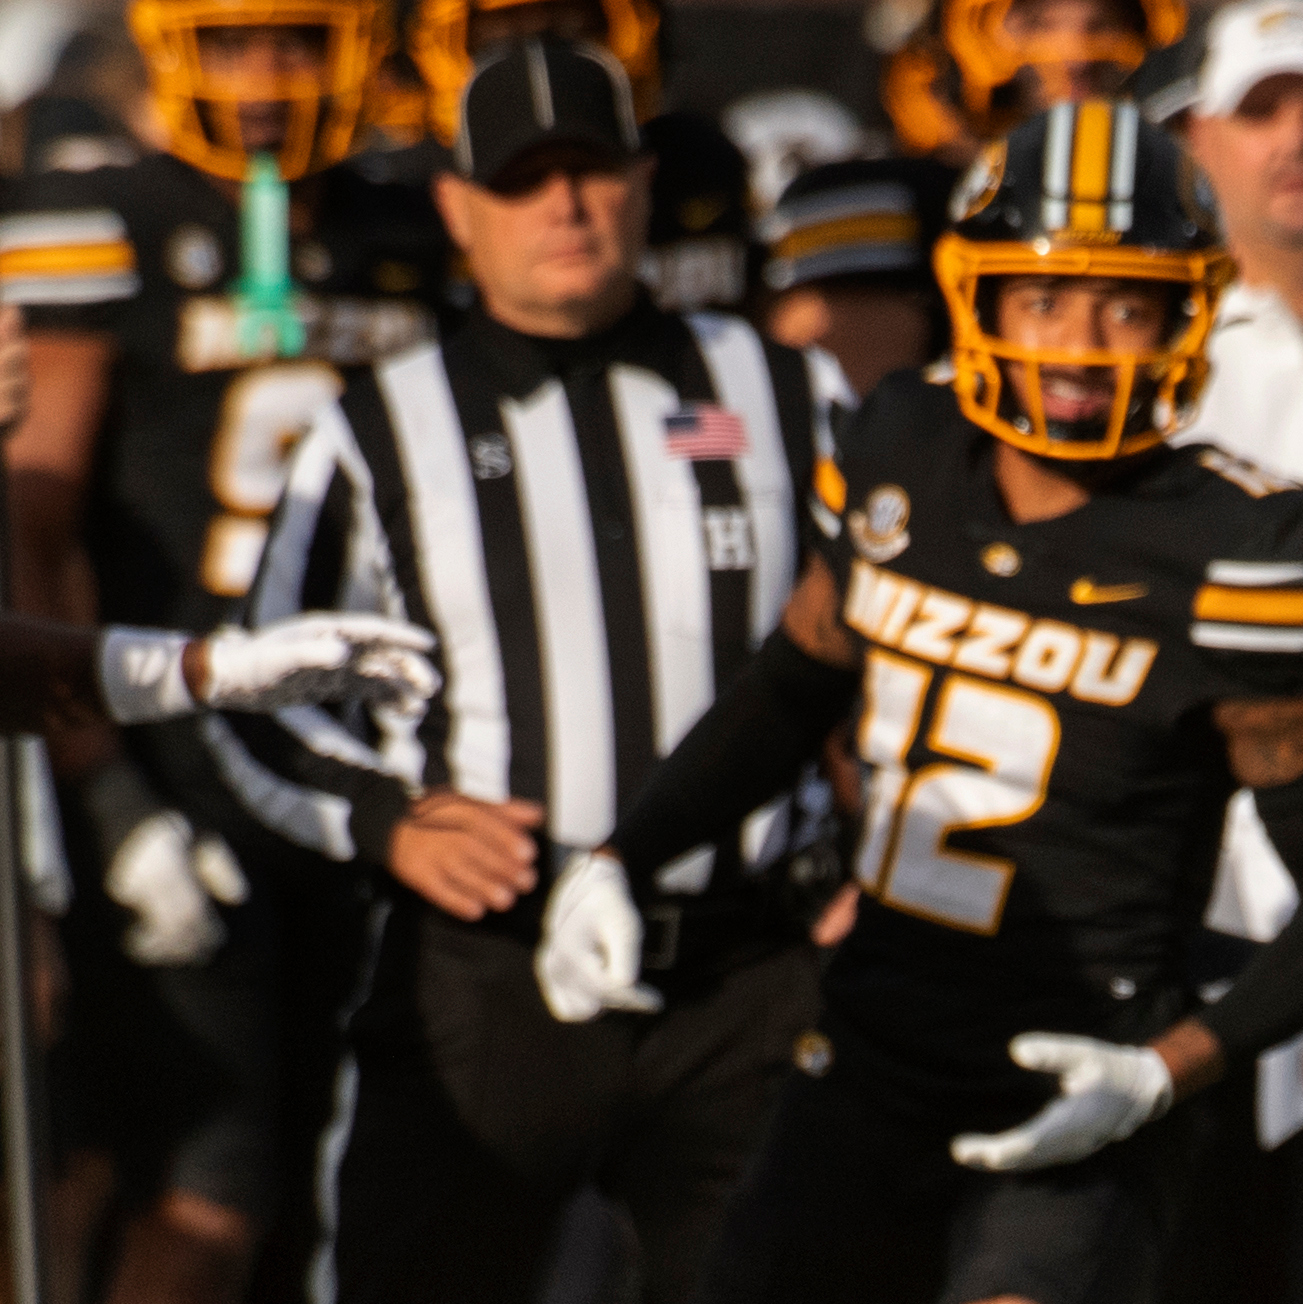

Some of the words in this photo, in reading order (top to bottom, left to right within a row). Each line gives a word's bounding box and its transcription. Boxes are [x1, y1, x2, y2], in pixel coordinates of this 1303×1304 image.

[704, 507, 758, 571] H
[844, 561, 1159, 707] MIZZOU
[853, 649, 1062, 937] 12
